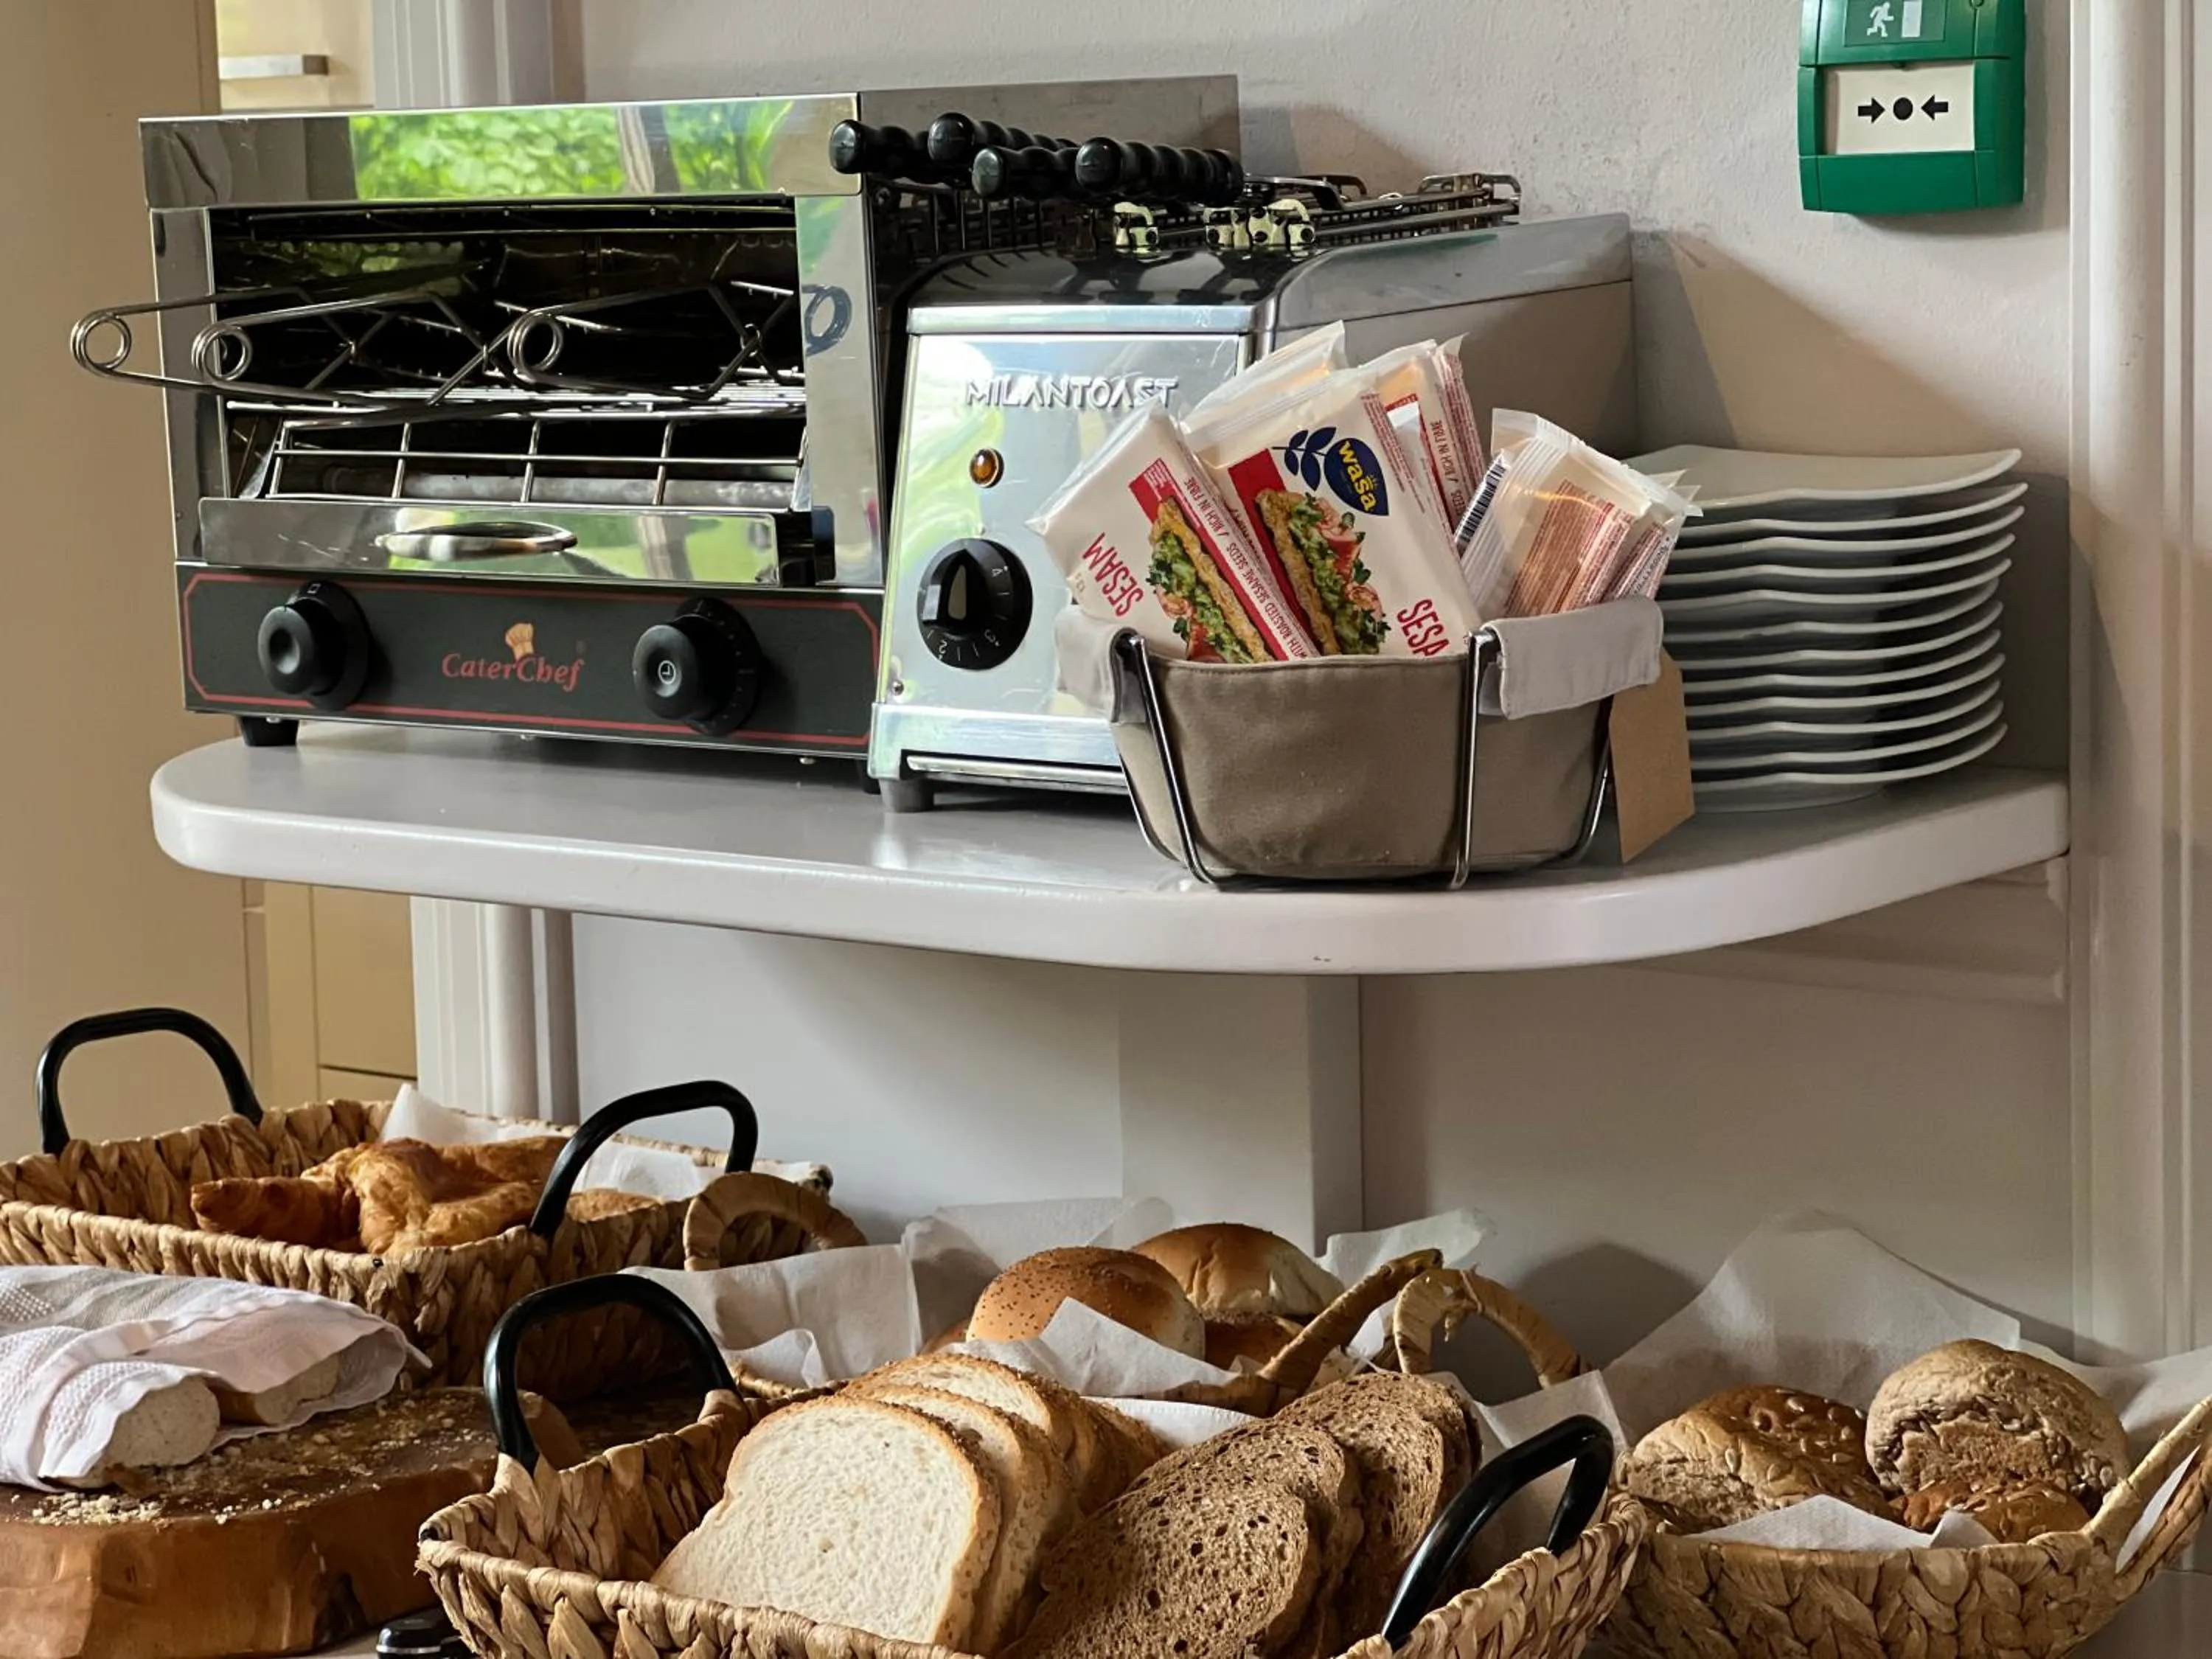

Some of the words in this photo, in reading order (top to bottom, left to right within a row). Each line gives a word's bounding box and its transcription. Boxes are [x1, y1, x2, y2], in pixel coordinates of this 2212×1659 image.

[964, 375, 1178, 408] MILANTOAST
[1184, 476, 1204, 501] FIBRE
[1197, 499, 1211, 511] IN
[1206, 509, 1225, 532] RICH
[1228, 542, 1248, 570] SEEDS
[1082, 532, 1144, 616] SESAM
[1242, 568, 1270, 604] SESAME
[1265, 602, 1292, 639] ROASTED
[1397, 599, 1450, 656] SESA
[1287, 639, 1307, 659] WITH
[442, 653, 585, 692] CaterChef
